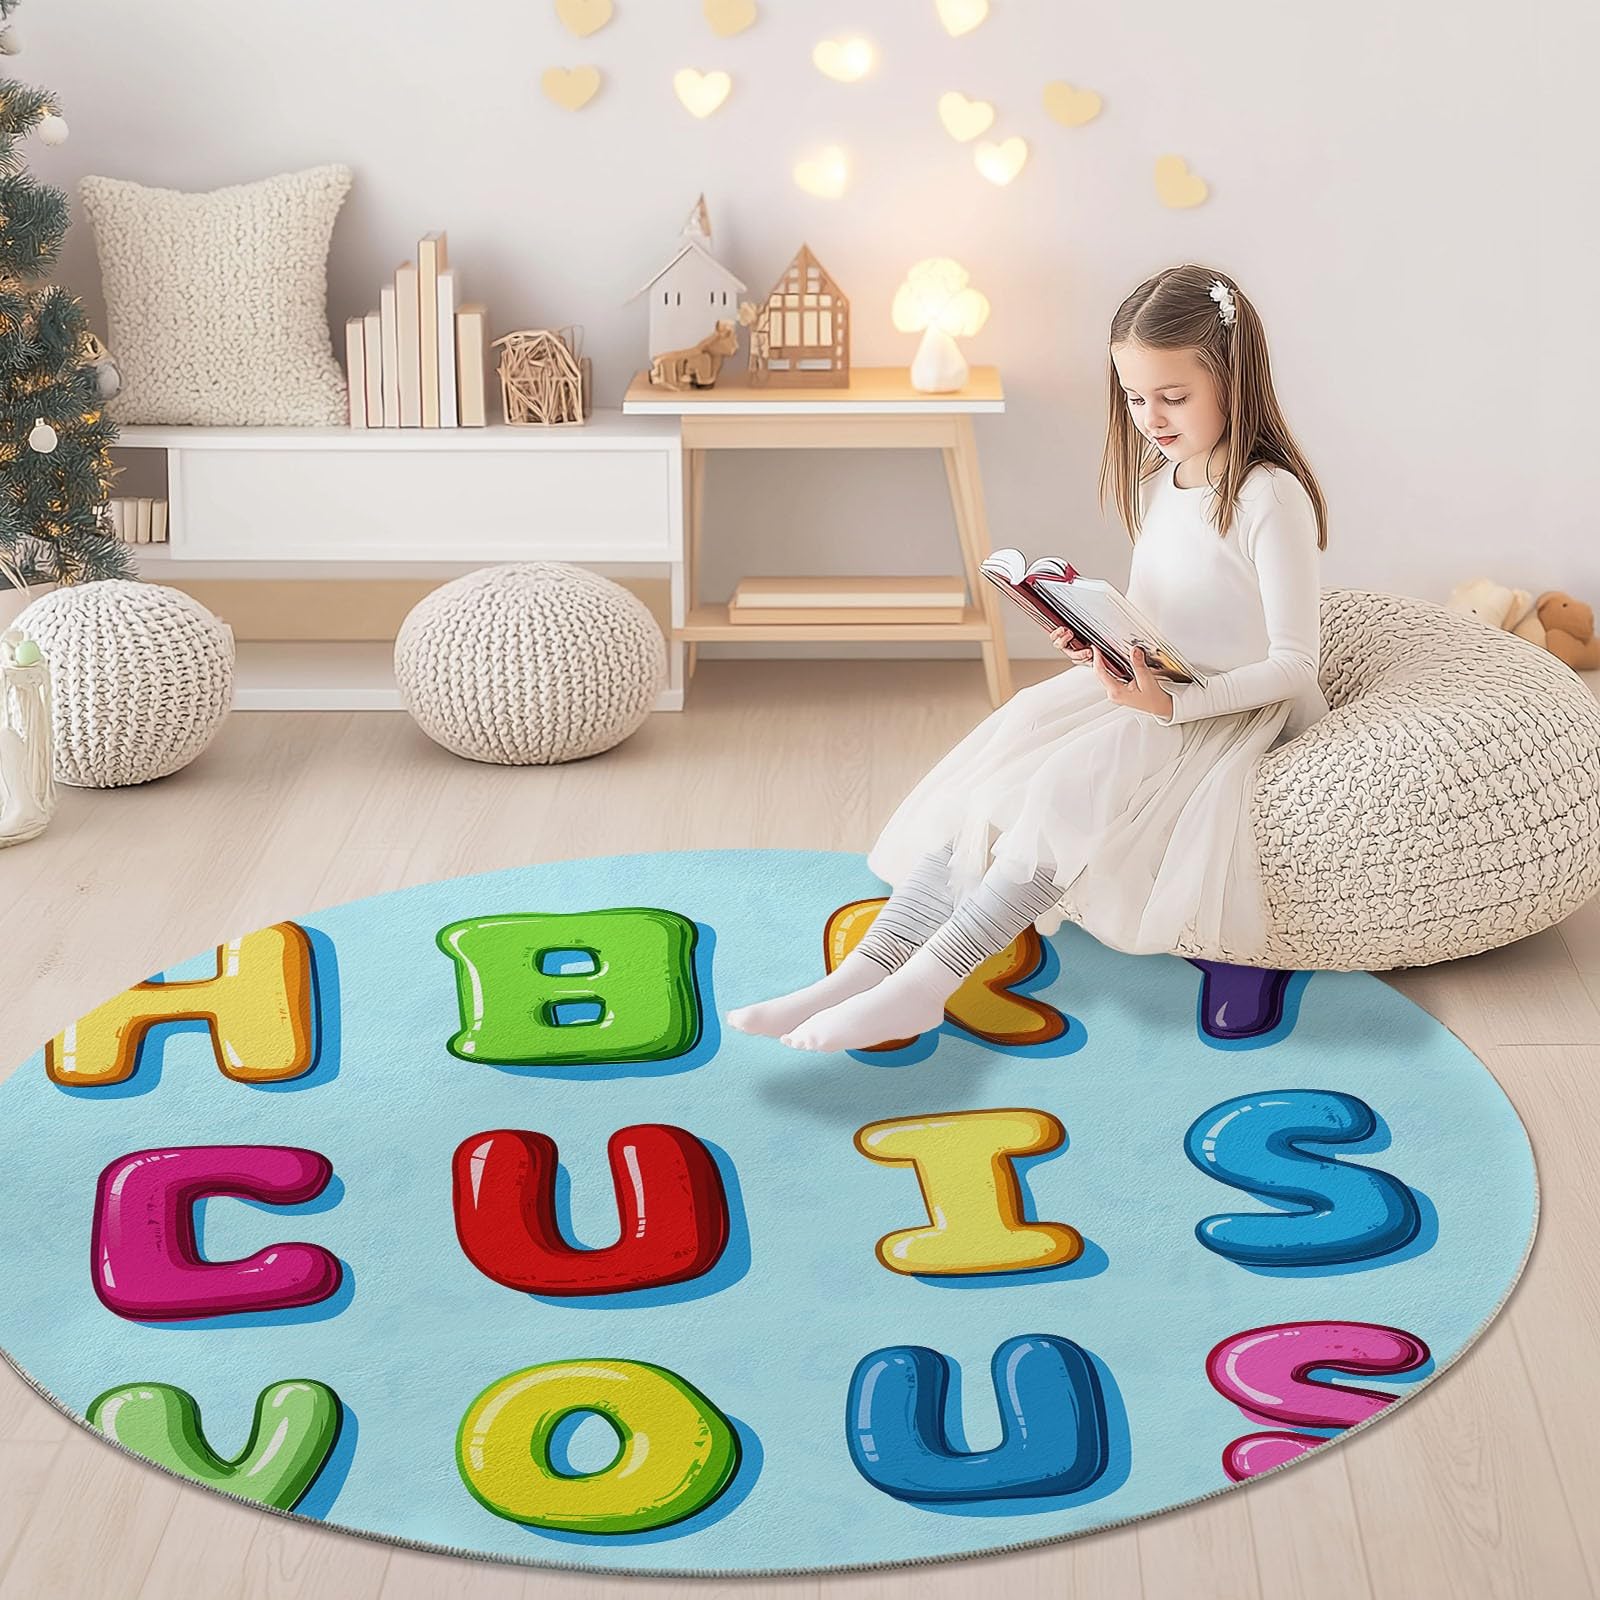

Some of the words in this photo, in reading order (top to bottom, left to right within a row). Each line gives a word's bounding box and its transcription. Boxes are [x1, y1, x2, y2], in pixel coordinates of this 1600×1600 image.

[436, 907, 702, 1066] B
[91, 1145, 343, 1321] C
[452, 1124, 730, 1296] U
[853, 1108, 1084, 1278] I
[1184, 1089, 1422, 1268] S
[456, 1357, 743, 1535] O
[846, 1333, 1108, 1503] U
